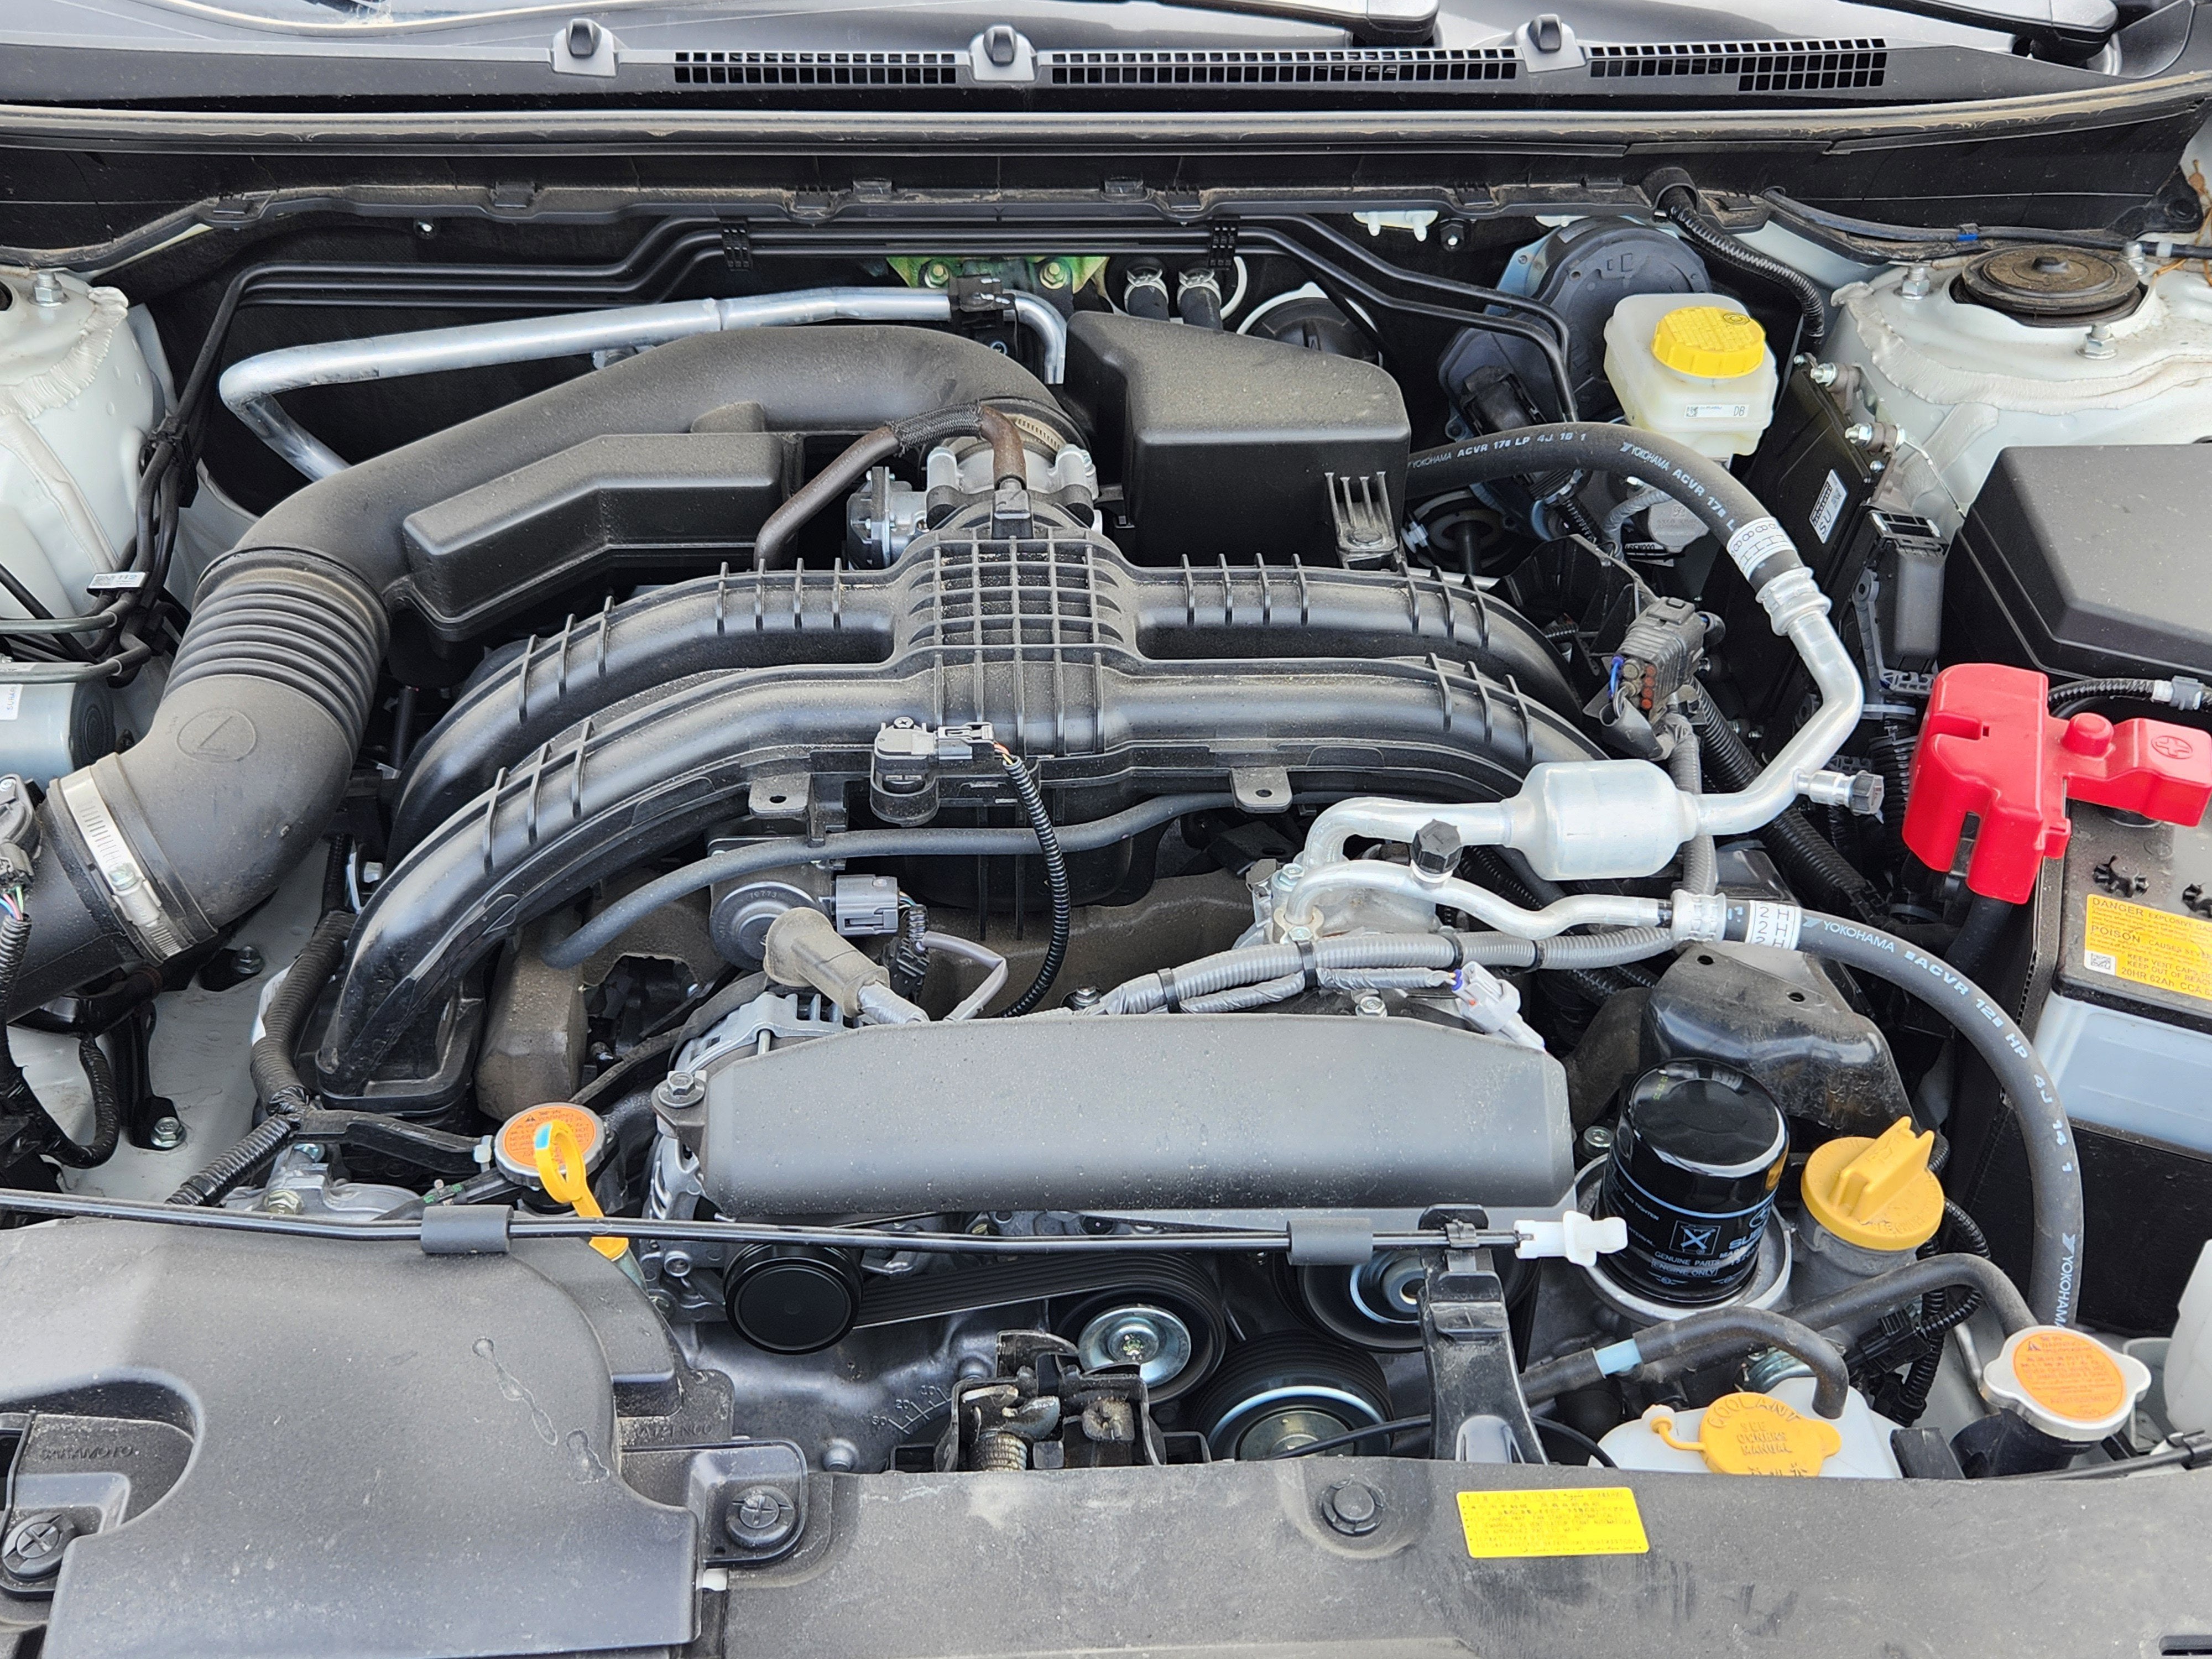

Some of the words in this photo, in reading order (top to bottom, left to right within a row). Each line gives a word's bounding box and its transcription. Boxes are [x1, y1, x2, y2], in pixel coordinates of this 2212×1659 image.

[1733, 406, 1745, 416] DB
[1412, 452, 1452, 469] YOKOHAMA
[1457, 444, 1488, 458] ACVR
[1515, 436, 1531, 446] LP
[1631, 444, 1671, 471] YOKOHAMA
[1672, 468, 1705, 497] ACVR
[1759, 906, 1770, 918] 2
[1777, 908, 1790, 921] H
[2092, 898, 2144, 916] DANGER
[1757, 921, 1768, 935] 2
[1775, 923, 1788, 937] H
[2091, 925, 2141, 943] POISON
[2127, 953, 2150, 964] KEEP
[2127, 960, 2149, 969] KEEP
[2152, 966, 2168, 975] OUT
[2121, 967, 2147, 979] 20HR
[2150, 974, 2175, 987] 62Ah
[2180, 982, 2202, 995] CCA
[1823, 920, 1895, 953] YOKOHAMA
[1914, 957, 1970, 996] ACVR
[2005, 1032, 2028, 1058] HP
[1654, 1251, 1691, 1266] GENUINE
[1653, 1261, 1687, 1275] ENGINE
[1692, 1268, 1716, 1276] ONLY
[895, 1399, 910, 1410] 20
[1707, 1395, 1802, 1428] COOLANT
[1740, 1421, 1766, 1431] SEE
[1740, 1443, 1793, 1455] MANUAL
